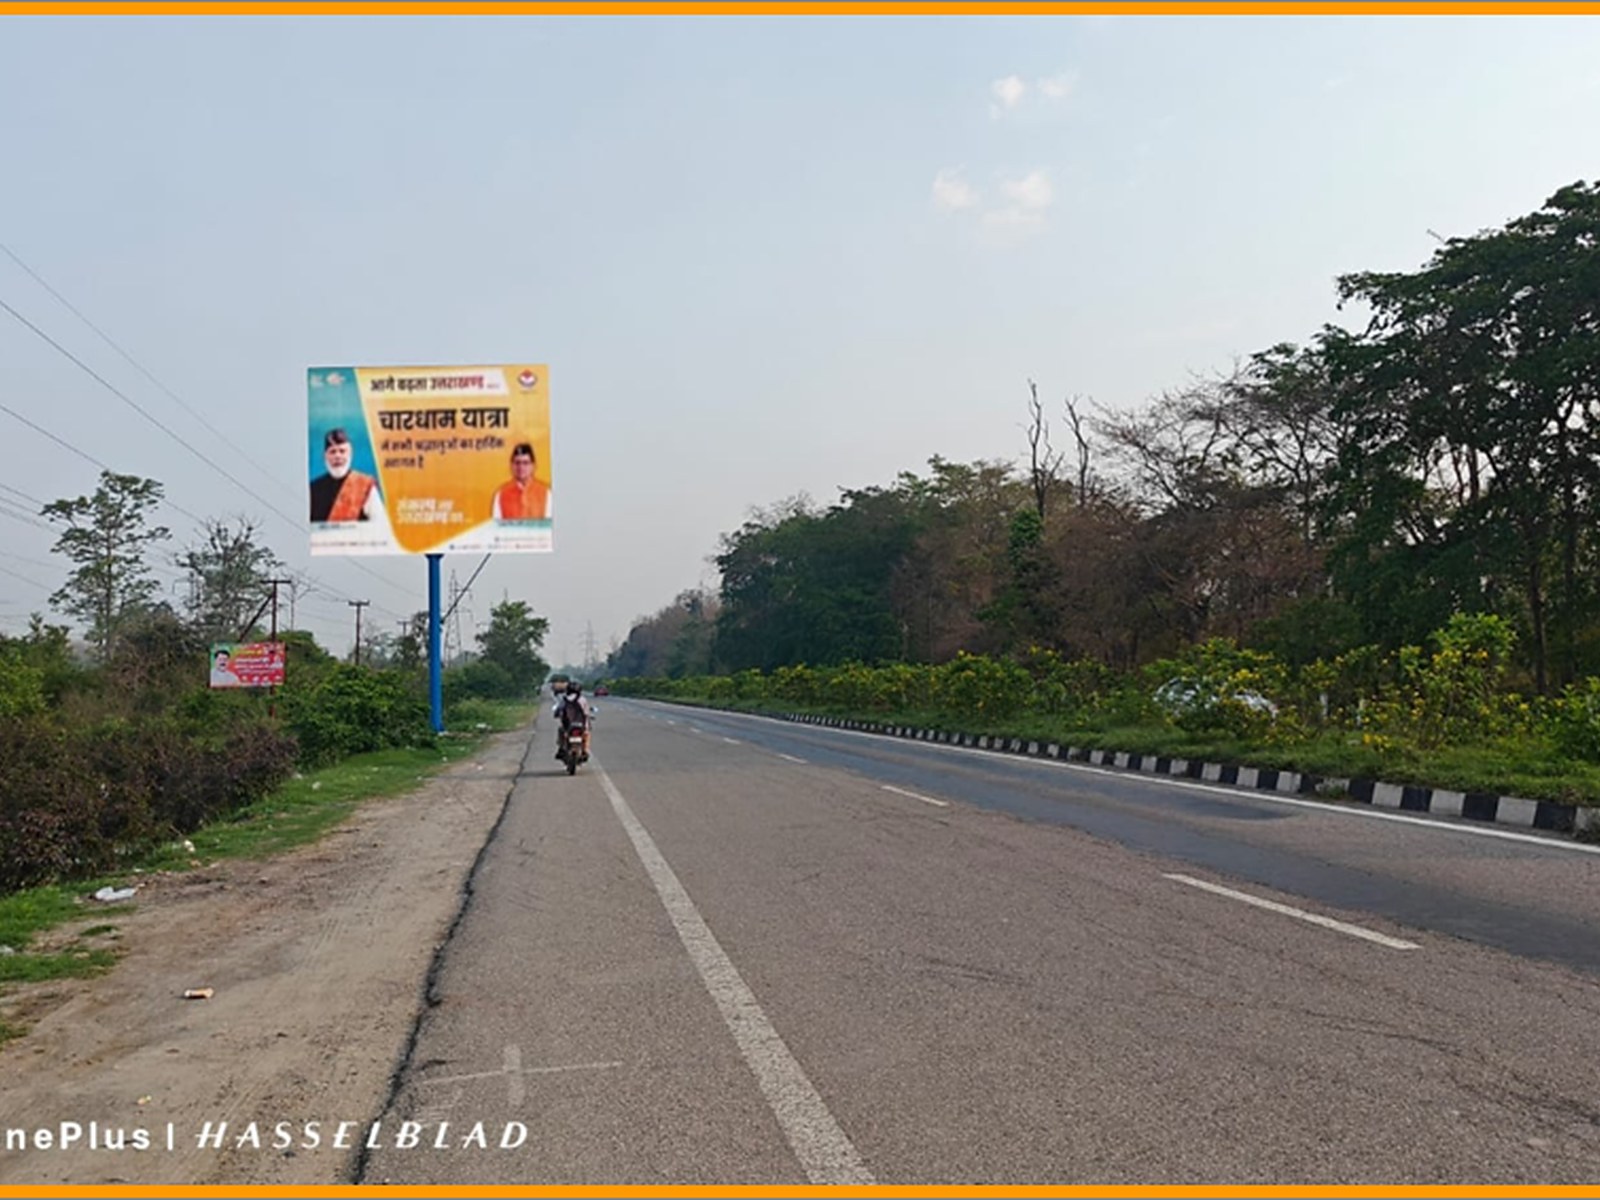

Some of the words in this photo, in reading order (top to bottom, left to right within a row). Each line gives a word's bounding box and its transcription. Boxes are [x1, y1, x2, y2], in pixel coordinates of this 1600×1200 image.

[370, 374, 394, 391] आगे
[378, 409, 457, 431] चारधाम
[461, 407, 509, 429] यात्रा
